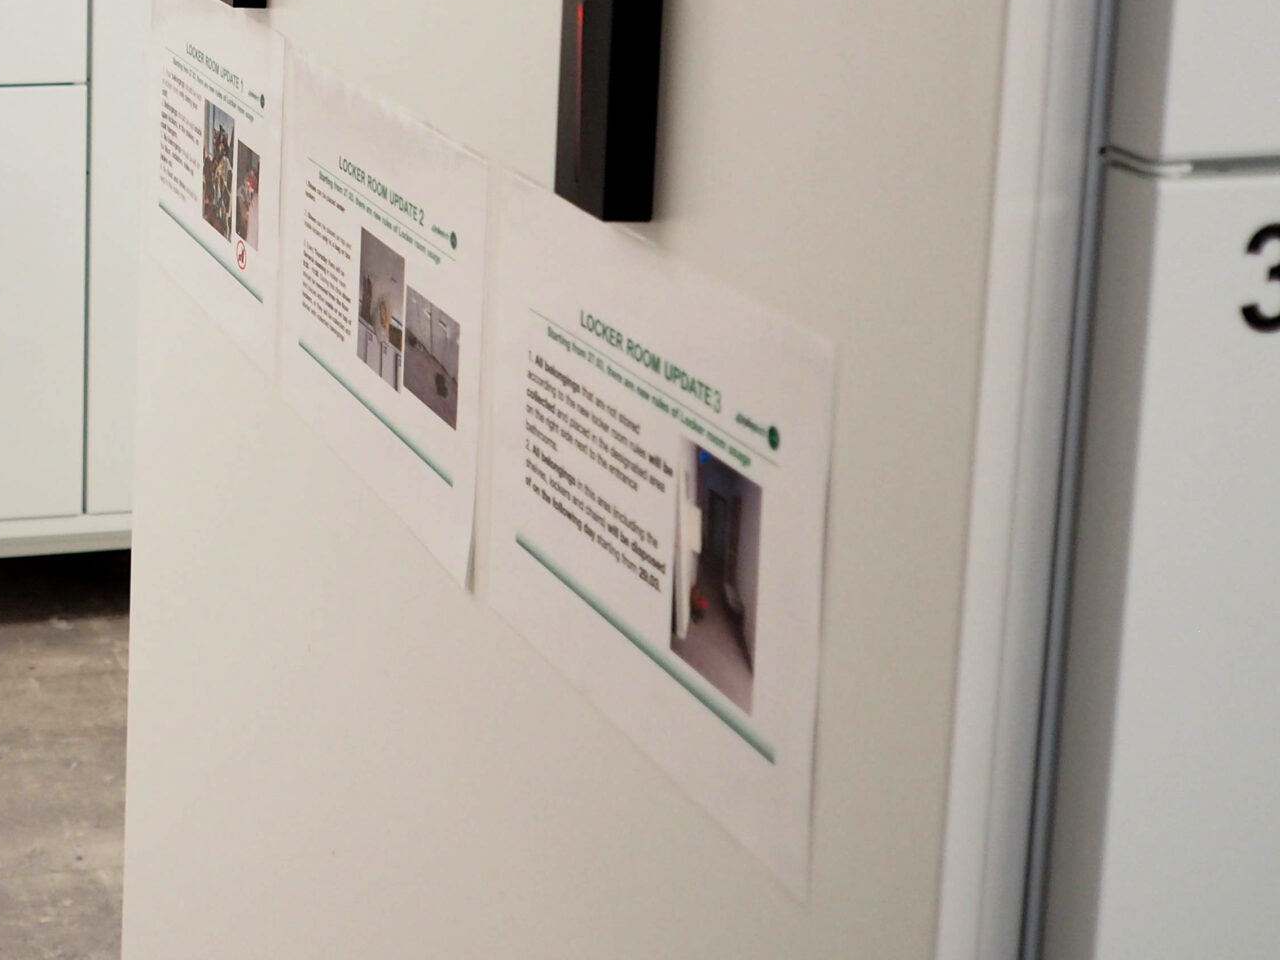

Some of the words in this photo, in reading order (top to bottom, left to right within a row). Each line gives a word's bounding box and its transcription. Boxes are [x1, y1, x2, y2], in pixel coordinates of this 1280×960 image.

[186, 42, 203, 64] LOCKER
[205, 55, 218, 75] ROOM
[220, 65, 238, 89] UPDATE
[338, 155, 365, 186] LOCKER
[367, 174, 387, 200] ROOM
[389, 189, 416, 221] UPDATE
[418, 209, 424, 226] 2
[544, 360, 580, 395] belongings
[547, 326, 570, 351] Starting
[680, 411, 704, 436] Locker
[580, 310, 622, 351] LOCKER
[626, 338, 660, 374] ROOM
[664, 361, 714, 407] UPDATE
[541, 451, 575, 487] belongings
